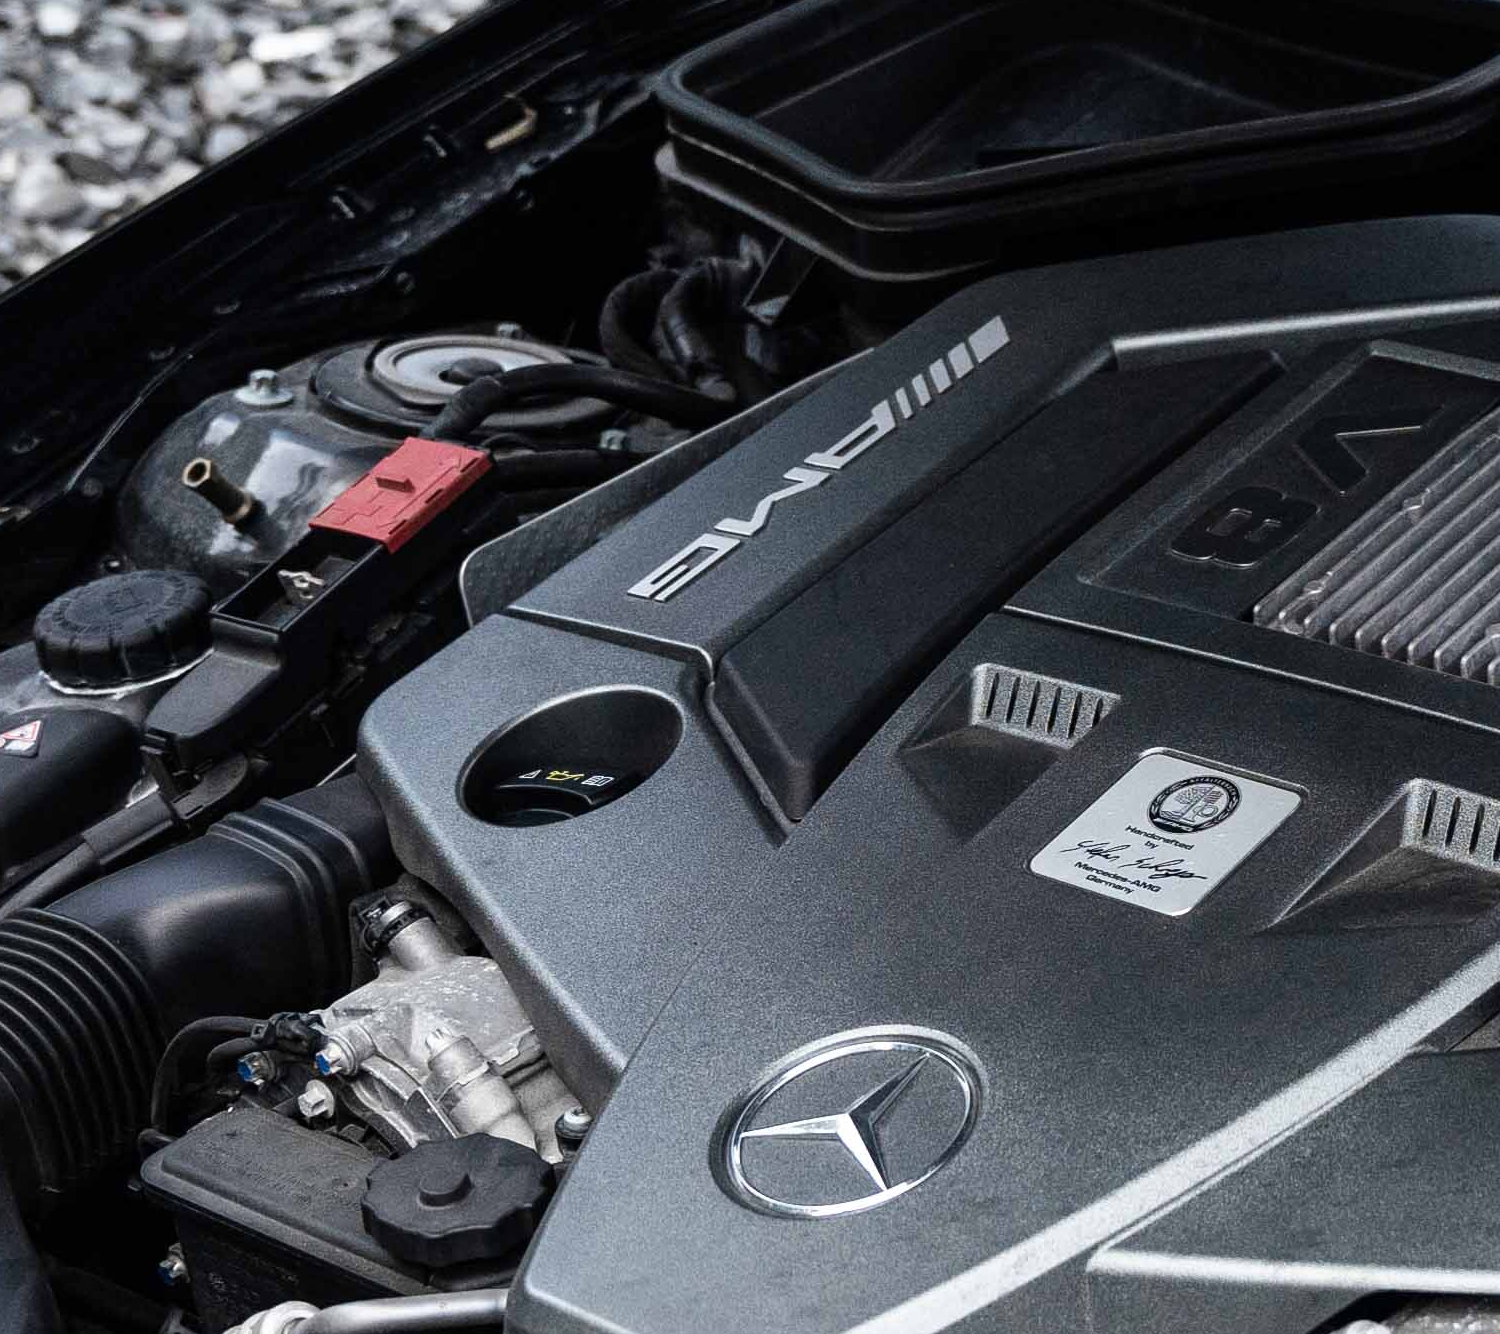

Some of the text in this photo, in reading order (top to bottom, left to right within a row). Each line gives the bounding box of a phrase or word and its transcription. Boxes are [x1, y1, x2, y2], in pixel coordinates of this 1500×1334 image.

[1125, 824, 1196, 851] Handcrafted
[1144, 840, 1159, 851] by
[1074, 860, 1162, 893] Mercedes-AMG
[1085, 873, 1134, 895] Germany
